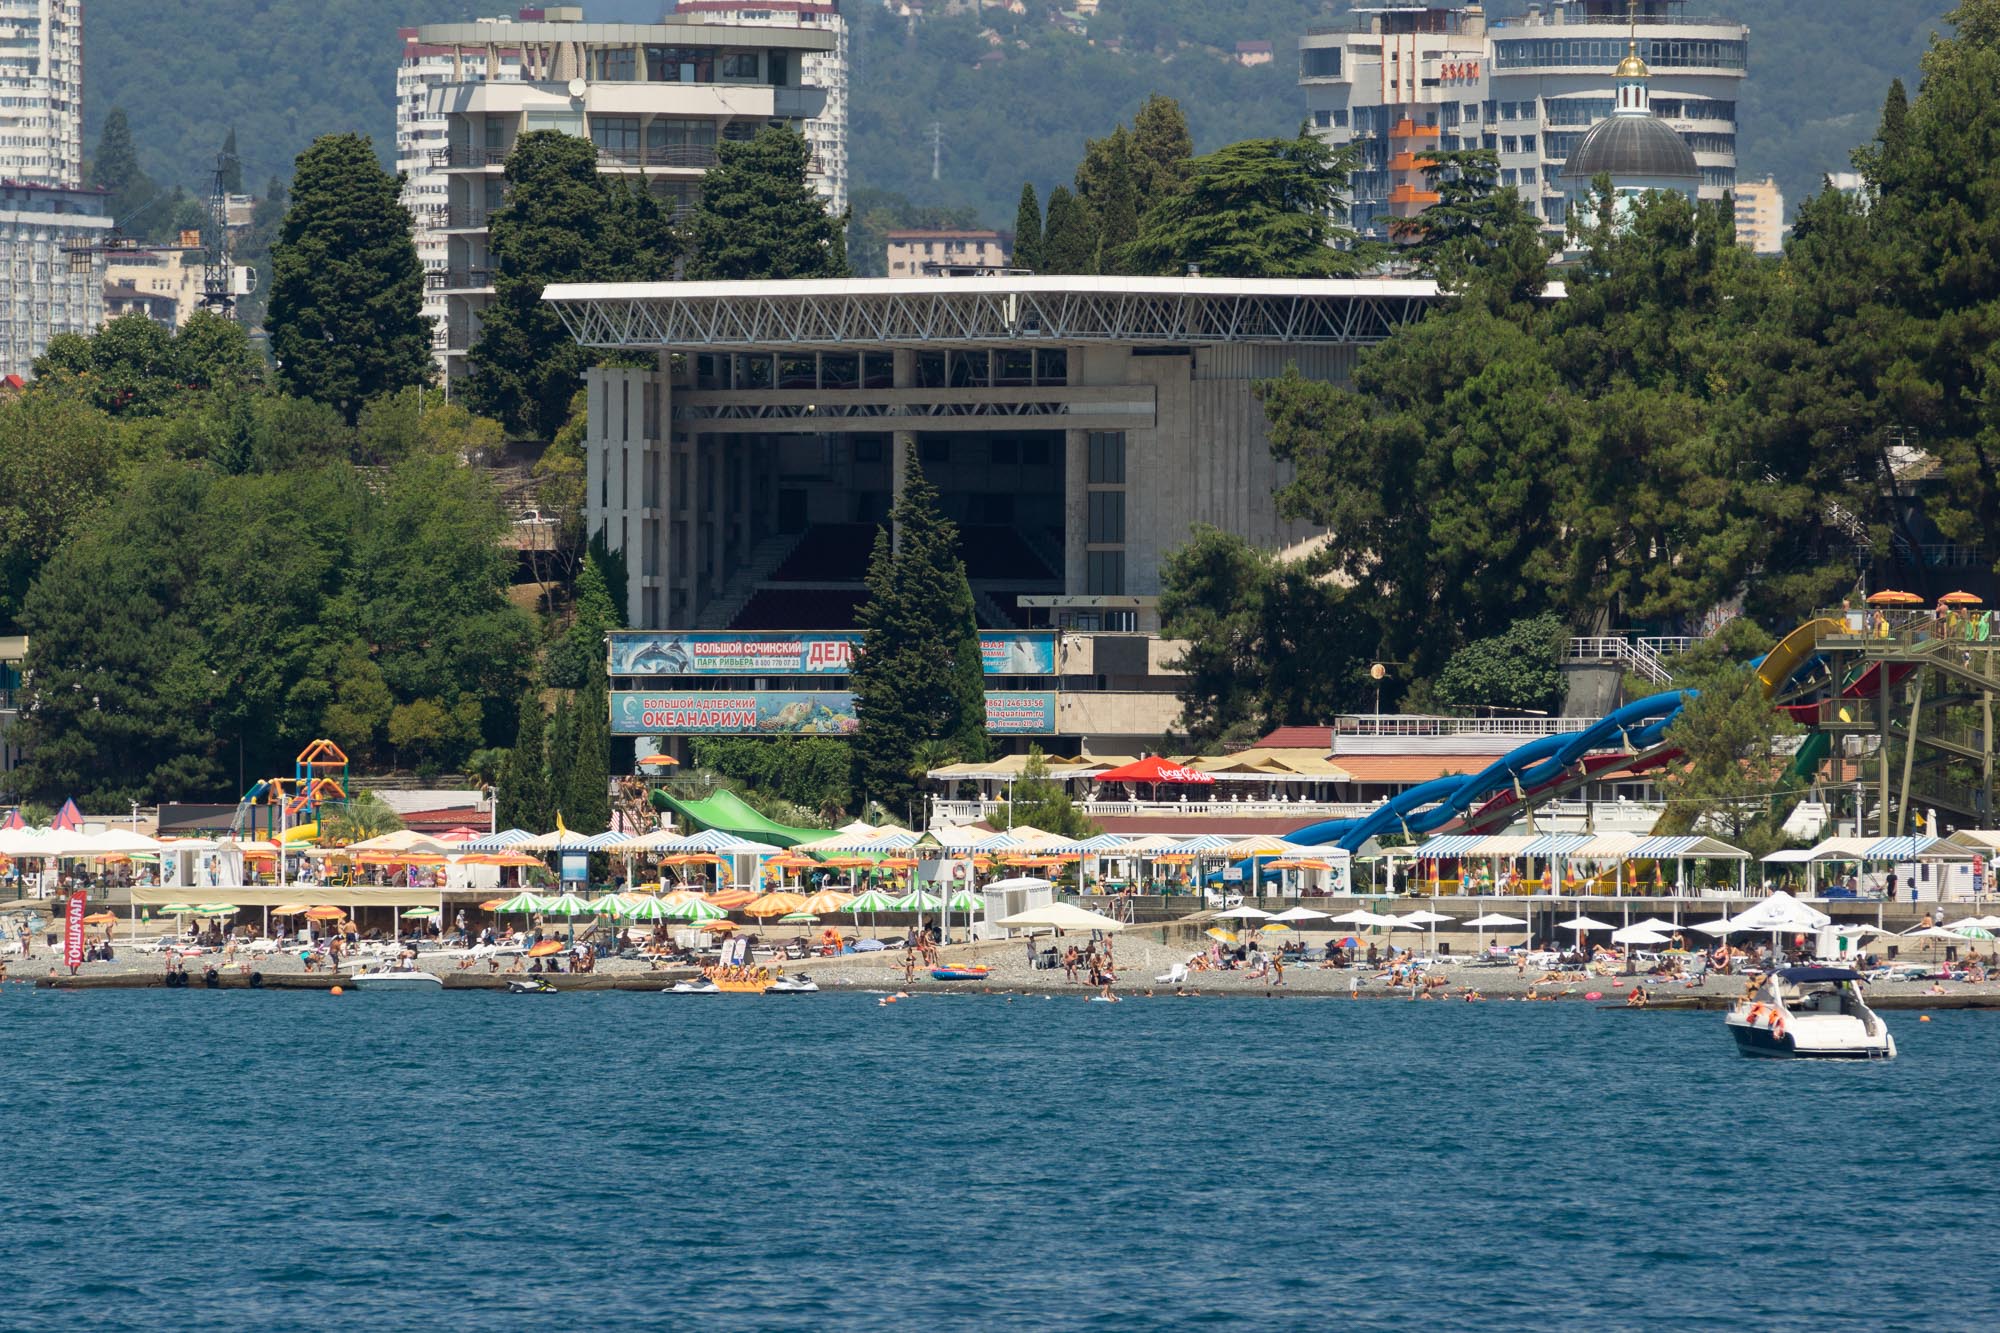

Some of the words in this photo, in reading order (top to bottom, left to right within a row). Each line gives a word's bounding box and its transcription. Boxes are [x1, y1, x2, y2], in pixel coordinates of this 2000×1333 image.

[695, 641, 742, 653] БОЛЬШОЙ
[744, 641, 801, 653] СОЧИНСКИЙ
[697, 658, 717, 666] ПАРК
[719, 658, 753, 666] РИВЬЕРА
[643, 697, 694, 709] БОЛЬШОЙ
[696, 697, 755, 710] АДЛЕРСКИЙ
[1006, 699, 1044, 707] 246-33-56
[642, 711, 756, 727] ОКЕАНАРИУМ
[985, 709, 1044, 719] hiaquarium.ru
